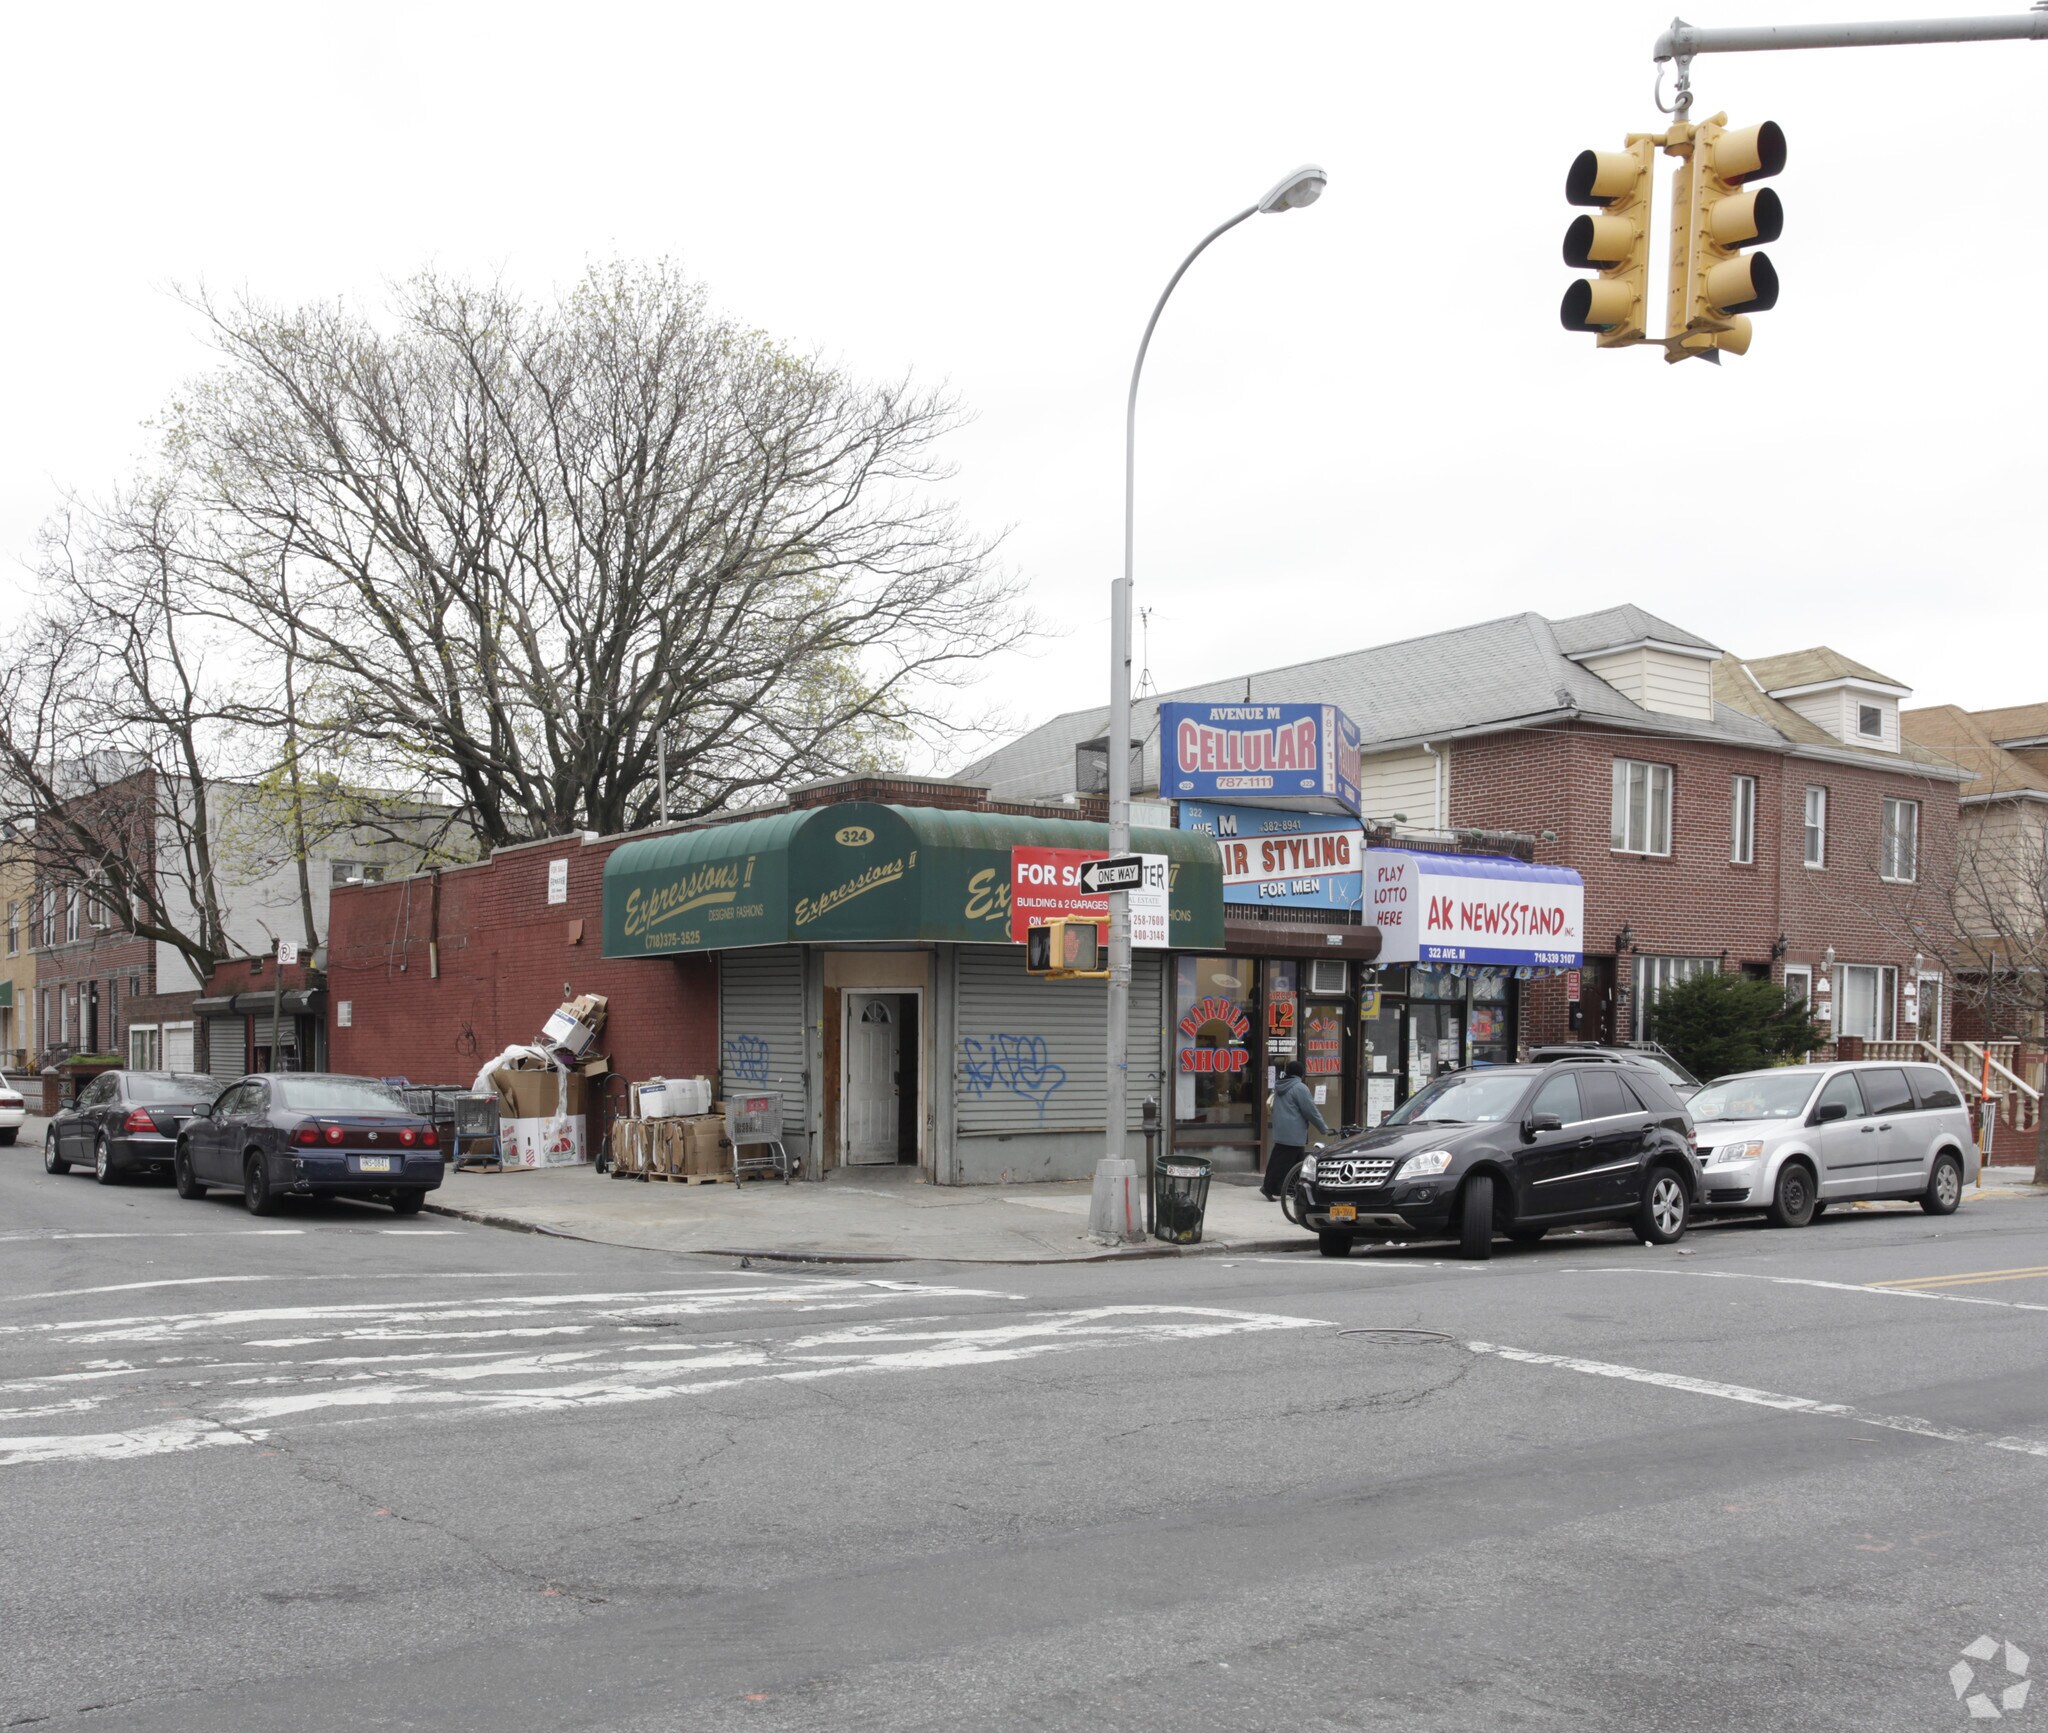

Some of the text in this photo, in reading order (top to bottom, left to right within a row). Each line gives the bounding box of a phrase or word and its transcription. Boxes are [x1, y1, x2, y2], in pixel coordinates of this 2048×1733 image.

[1209, 706, 1281, 721] AVENUE M
[1177, 716, 1317, 774] CELLULAR
[1181, 782, 1193, 790] 322
[1218, 777, 1273, 788] 787-1111
[1188, 808, 1203, 818] 322
[1217, 814, 1238, 837] M
[1263, 820, 1301, 833] 382-8941
[842, 830, 868, 843] 324
[1262, 835, 1350, 873] STYLING
[1017, 863, 1058, 886] FOR
[1099, 867, 1137, 884] ONE WAY
[1377, 864, 1405, 883] PLAY
[795, 858, 904, 926] Expressions
[1259, 879, 1321, 898] FOR MEN
[1374, 886, 1407, 904] LOTTO
[624, 862, 739, 936] Expressions
[1017, 897, 1109, 911] BUILDING & 2 GARAGES
[708, 903, 764, 922] DESIGNER FASHIONS
[1029, 916, 1042, 926] ON
[1133, 914, 1165, 927] 258-7600
[1377, 910, 1402, 927] HERE
[1427, 895, 1454, 931] AK
[1460, 901, 1565, 936] NEWSSTAND
[645, 930, 700, 950] (718)375-3525
[1133, 929, 1165, 941] 400-3146
[1428, 948, 1466, 959] 322 AVE. M
[1534, 952, 1575, 964] 718-339 3107
[1179, 995, 1250, 1040] BARBER
[1268, 1001, 1294, 1028] 12
[1309, 1016, 1338, 1033] WIG
[1308, 1039, 1339, 1051] HAIR
[1181, 1047, 1249, 1073] SHOP
[1305, 1056, 1341, 1073] SALON
